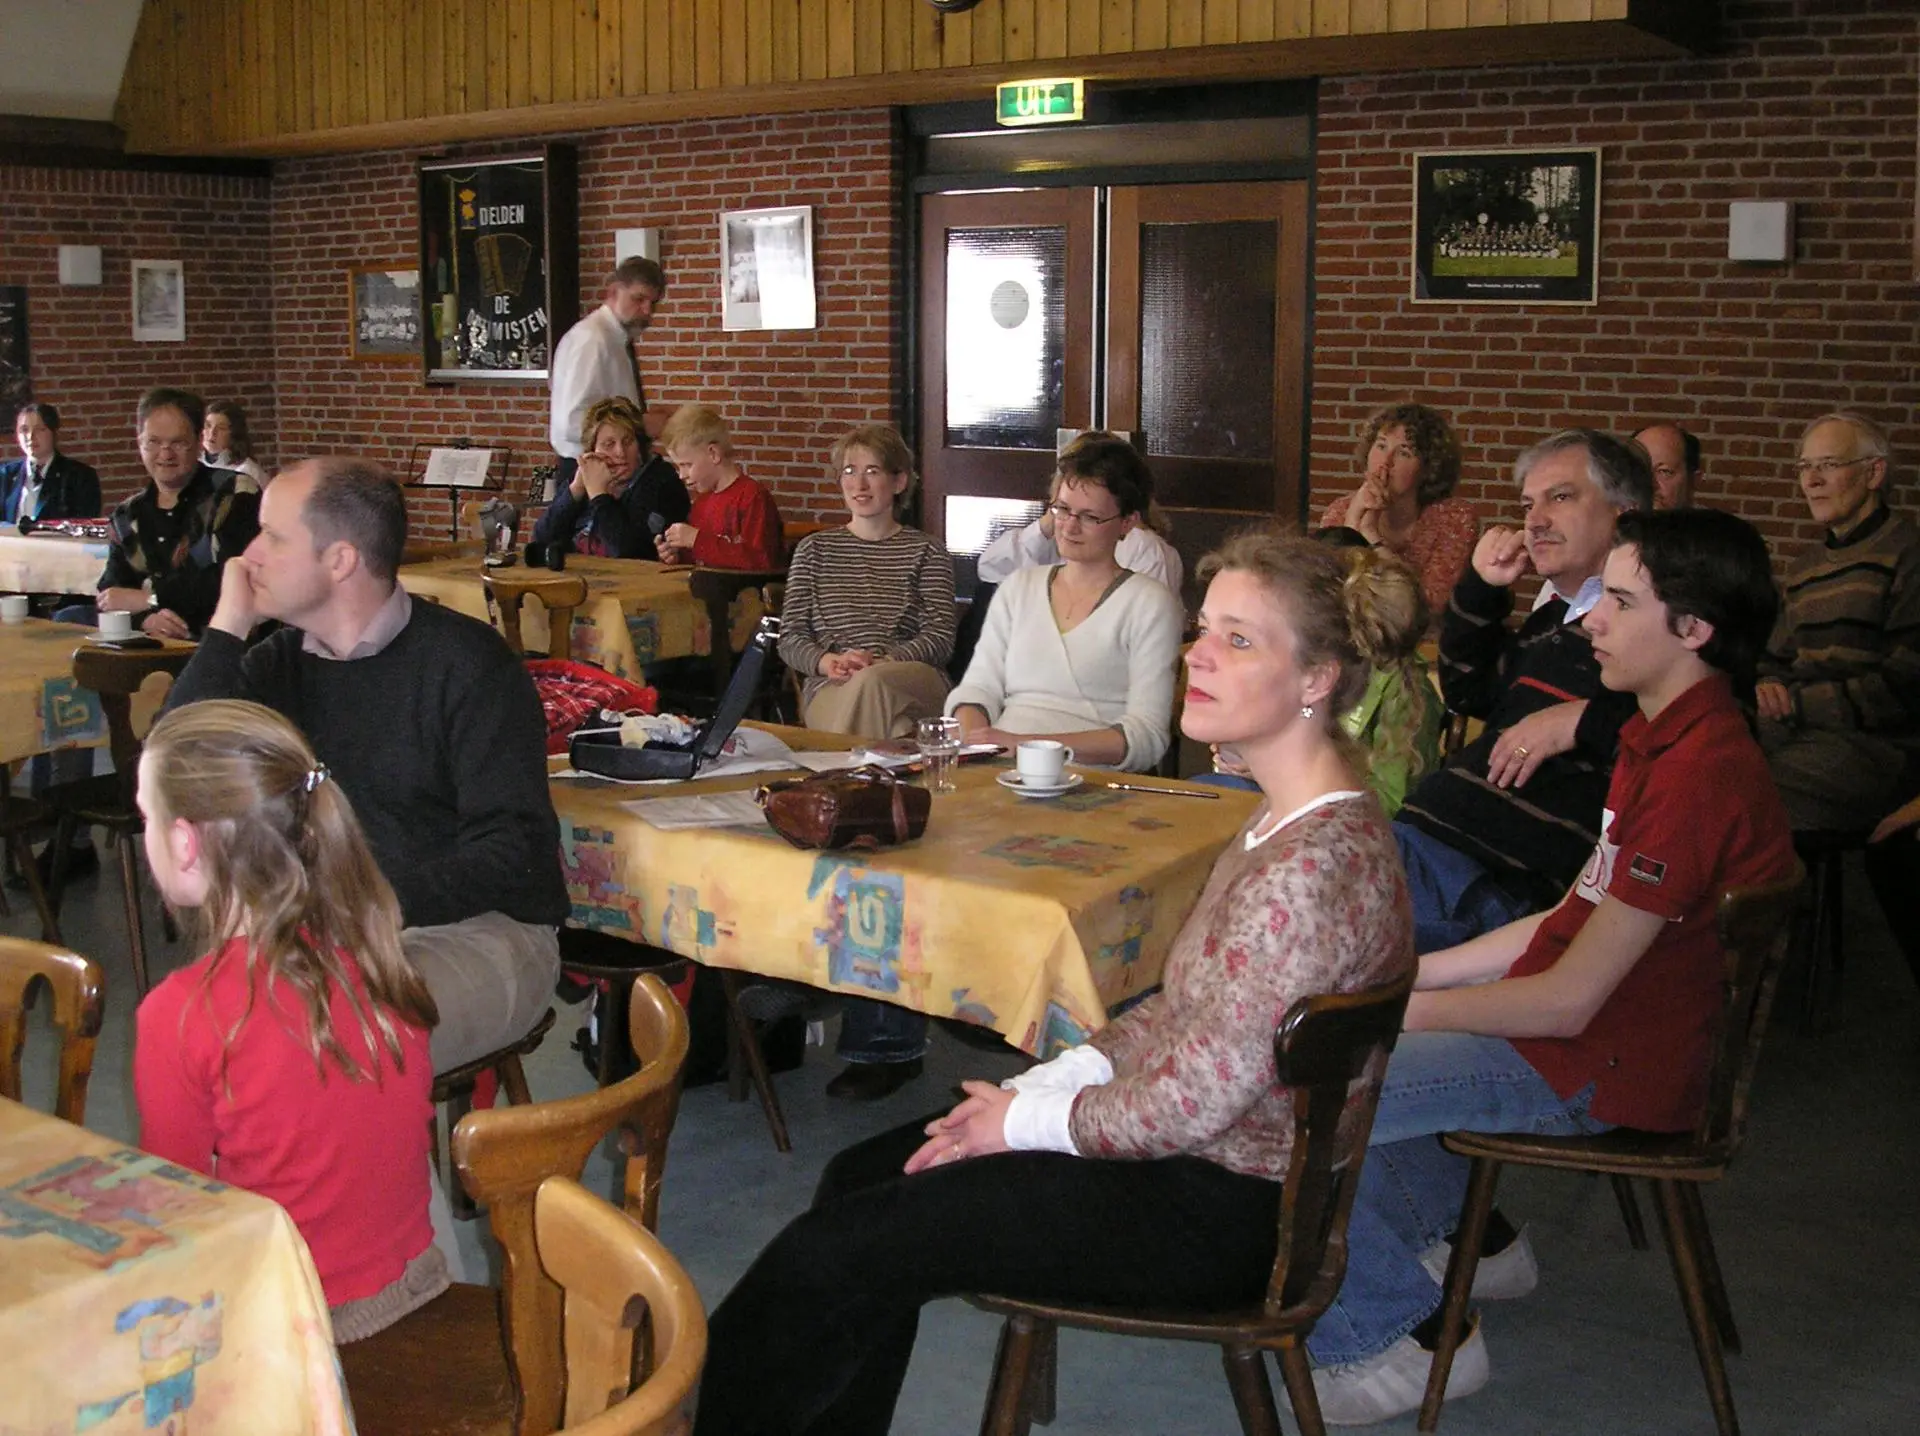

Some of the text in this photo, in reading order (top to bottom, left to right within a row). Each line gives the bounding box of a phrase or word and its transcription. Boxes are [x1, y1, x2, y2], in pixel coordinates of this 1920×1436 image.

[1016, 84, 1056, 116] UIT
[479, 204, 524, 226] DELDEN
[495, 295, 510, 314] DE
